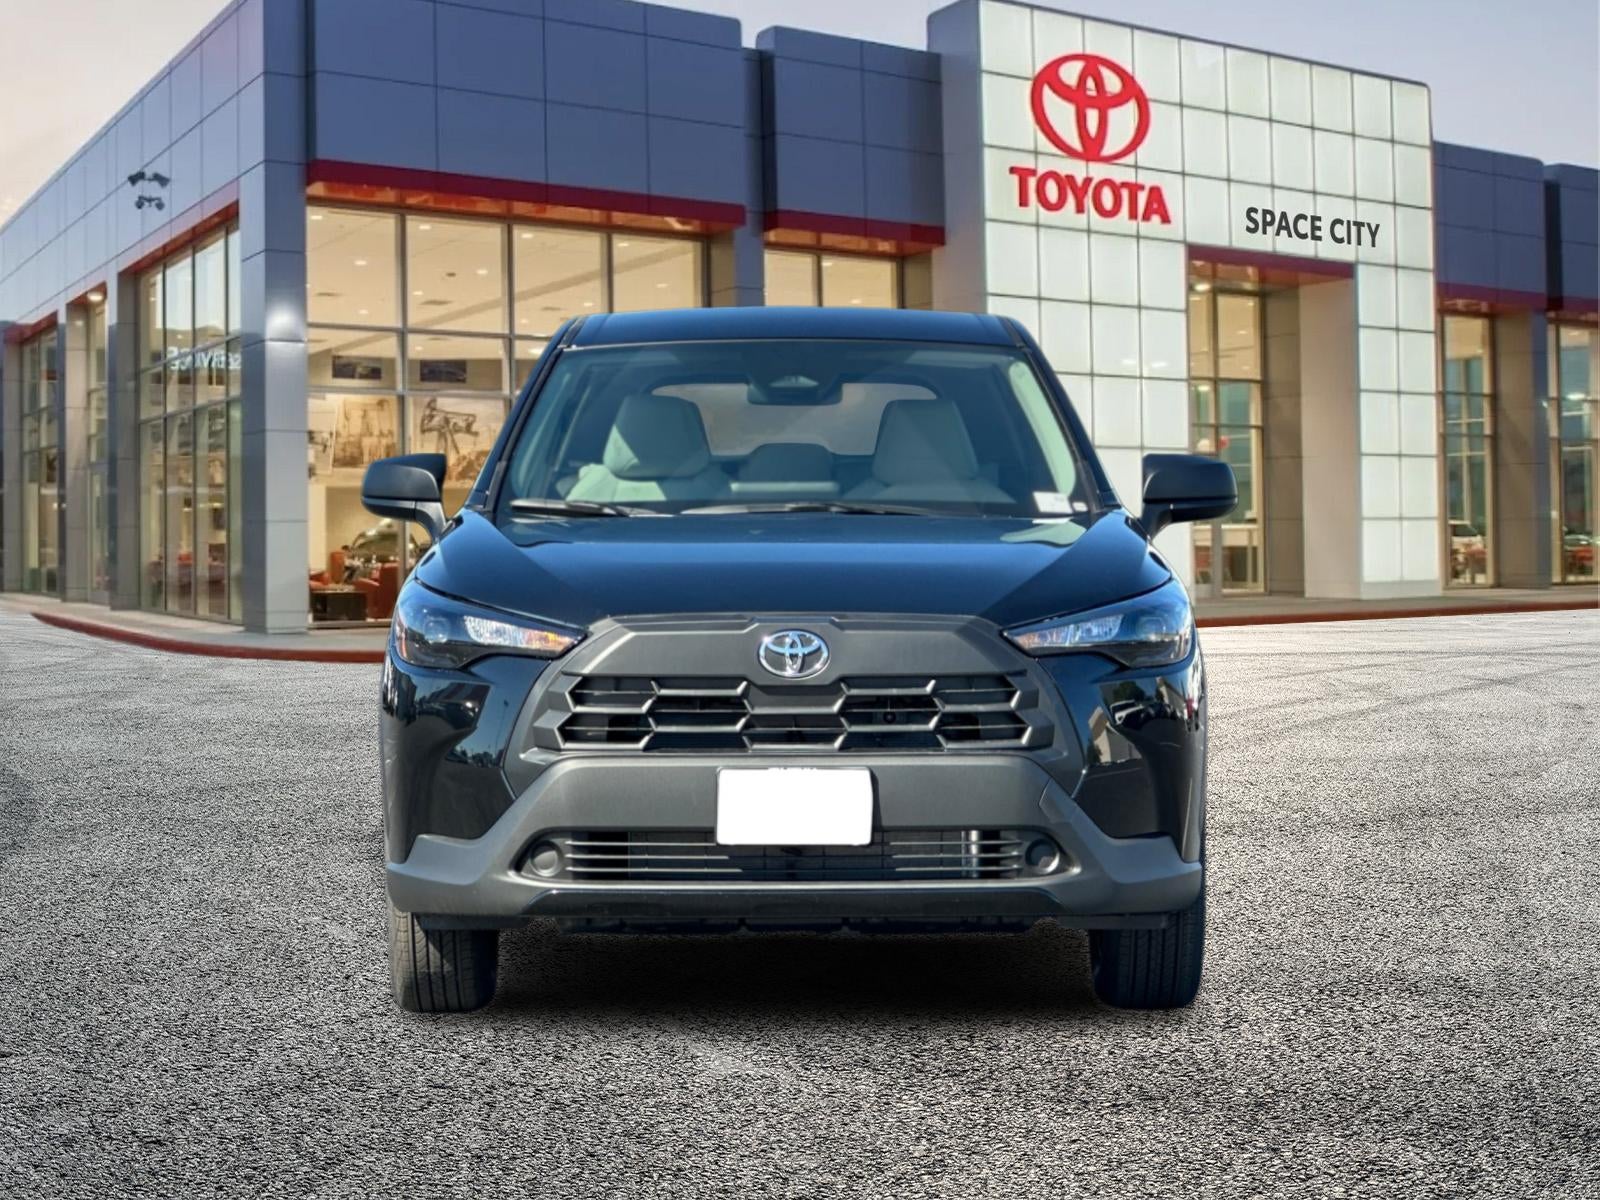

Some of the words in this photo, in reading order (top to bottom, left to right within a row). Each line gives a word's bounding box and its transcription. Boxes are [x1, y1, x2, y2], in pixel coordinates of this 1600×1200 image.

[1009, 166, 1171, 224] TOYOTA
[1245, 207, 1322, 241] SPACE
[1329, 218, 1380, 248] CITY
